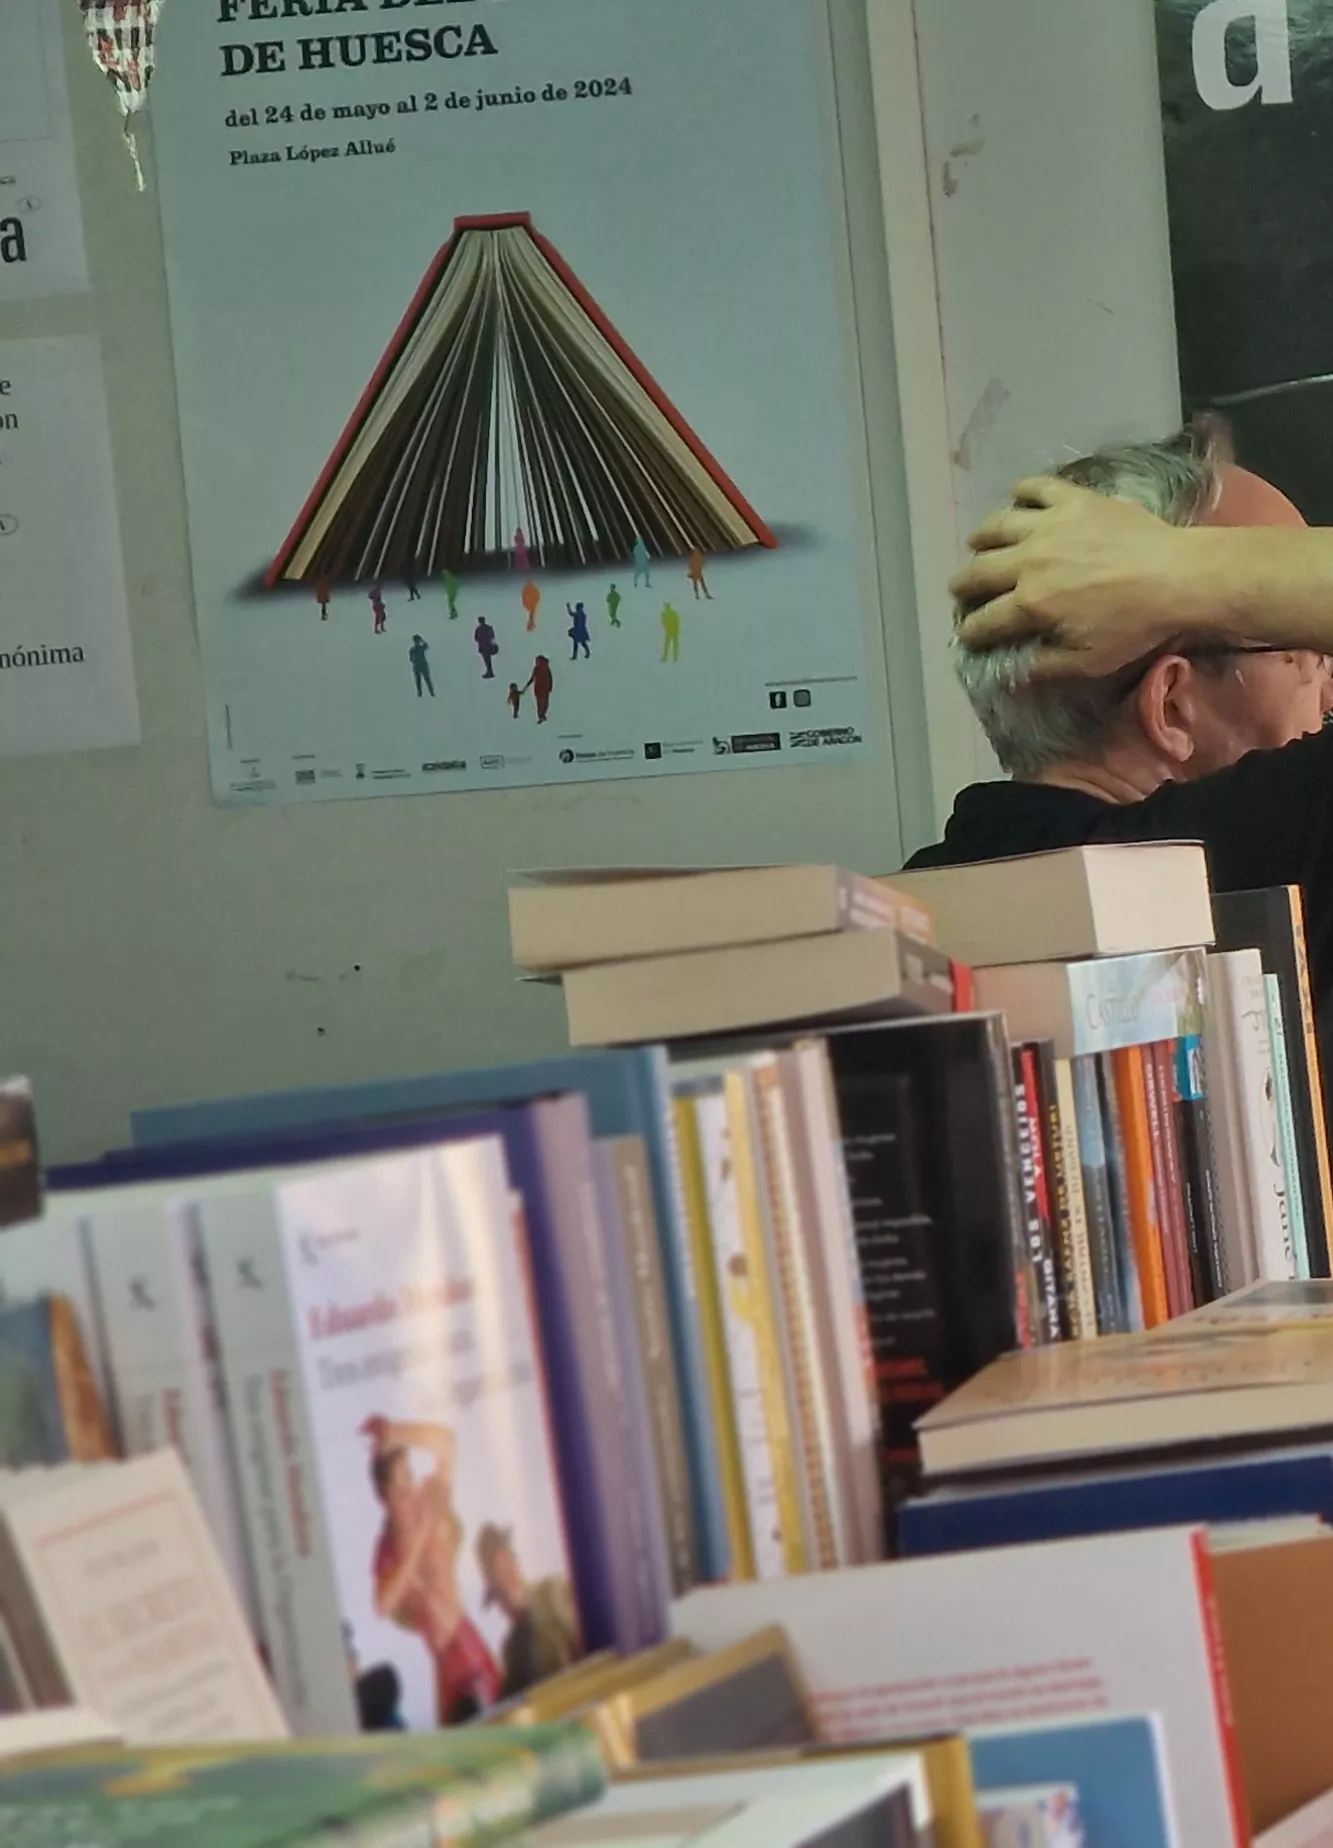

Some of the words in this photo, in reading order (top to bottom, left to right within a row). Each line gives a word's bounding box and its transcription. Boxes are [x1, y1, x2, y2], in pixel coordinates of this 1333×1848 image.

[220, 41, 286, 75] DE
[297, 23, 498, 70] HUESCA
[225, 108, 257, 127] del
[265, 104, 294, 124] 24
[301, 102, 326, 121] de
[333, 103, 390, 121] mayo
[397, 95, 417, 113] al
[425, 93, 438, 111] 2
[445, 90, 470, 109] de
[475, 86, 535, 111] junio
[541, 83, 567, 102] de
[574, 77, 632, 99] 2024
[229, 149, 281, 166] Plaza
[287, 144, 339, 164] López
[345, 138, 395, 157] Allué
[0, 644, 84, 669] nónima
[1016, 1084, 1037, 1204] VENCEJOS
[1027, 1220, 1043, 1263] LOS
[1041, 1258, 1060, 1339] GITANA
